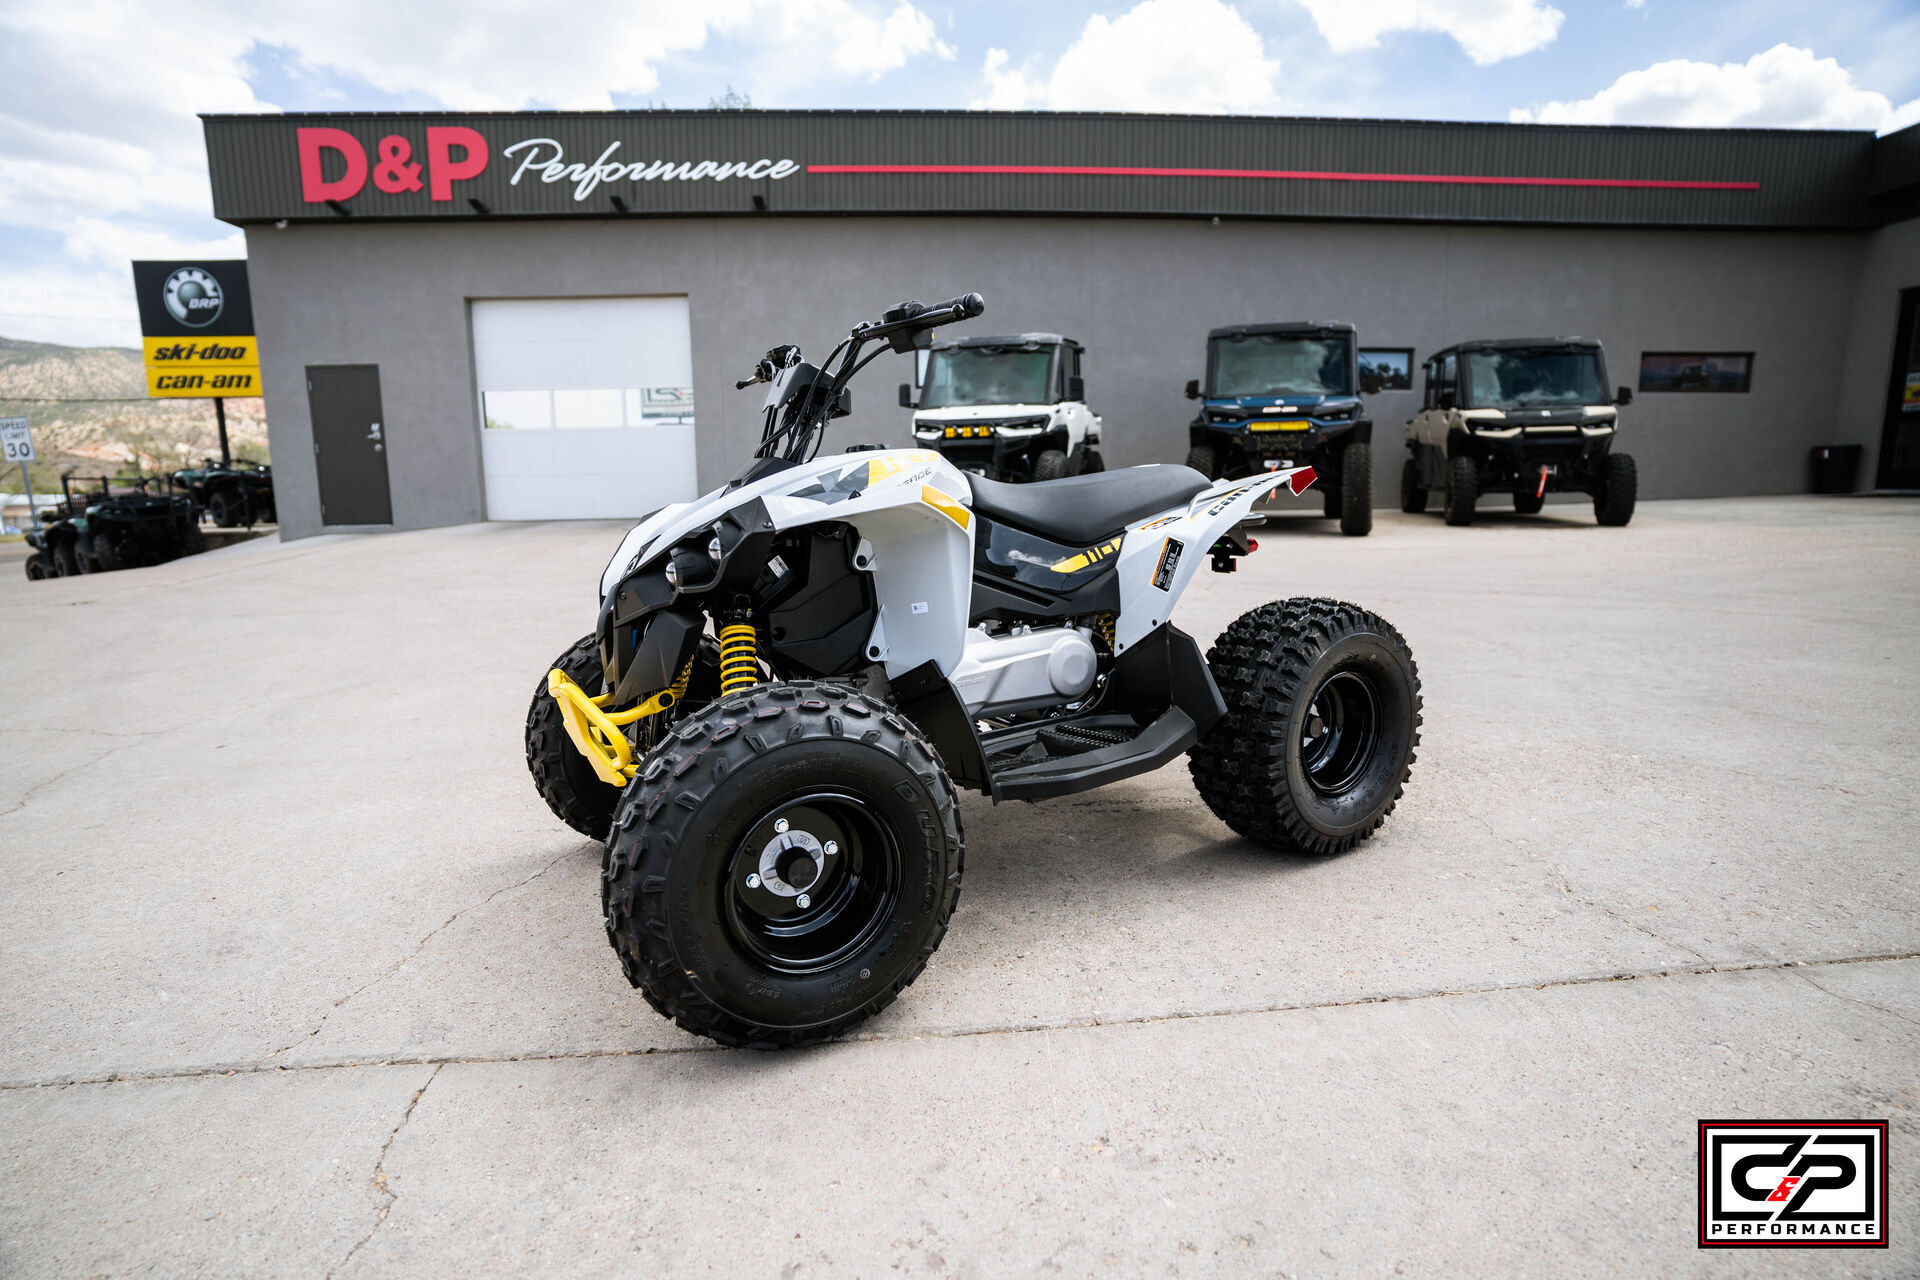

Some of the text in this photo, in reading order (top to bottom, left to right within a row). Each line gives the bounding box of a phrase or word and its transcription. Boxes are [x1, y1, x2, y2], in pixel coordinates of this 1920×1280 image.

[296, 126, 800, 202] D&P Performance
[189, 298, 219, 309] BRP
[154, 344, 246, 360] ski-doo
[156, 375, 252, 389] can-am
[0, 422, 26, 430] SPEED
[7, 442, 30, 458] 30
